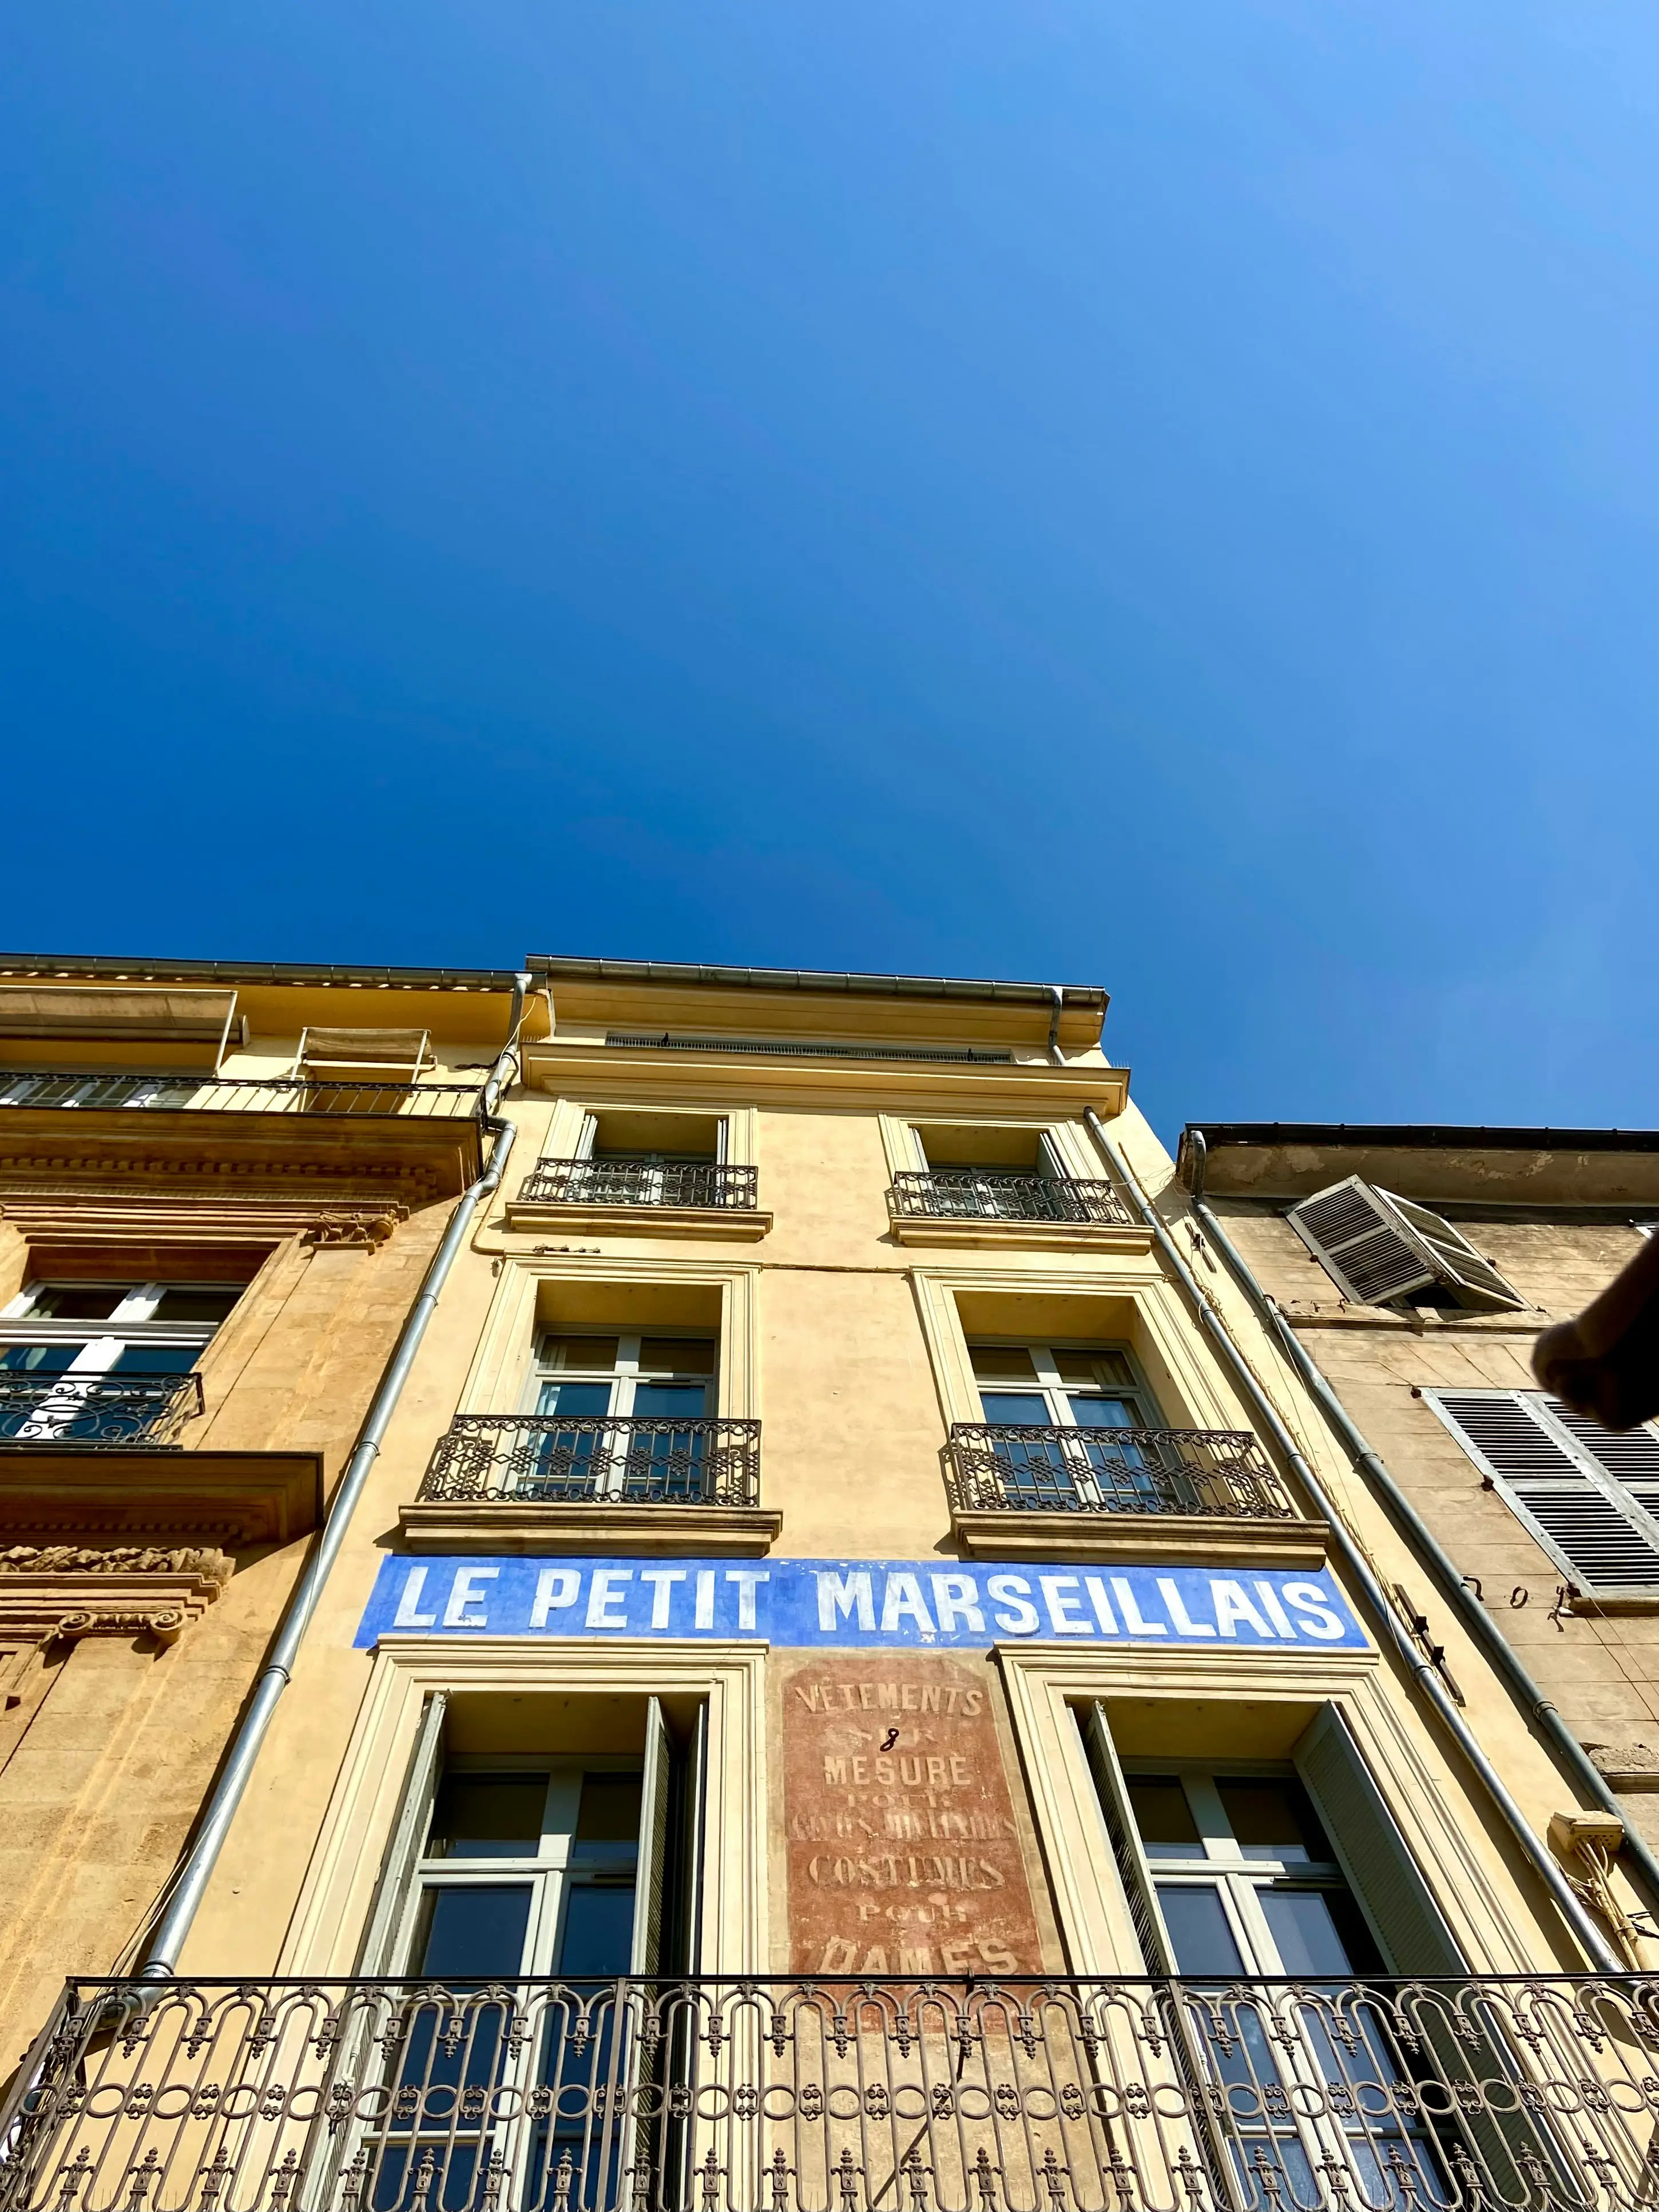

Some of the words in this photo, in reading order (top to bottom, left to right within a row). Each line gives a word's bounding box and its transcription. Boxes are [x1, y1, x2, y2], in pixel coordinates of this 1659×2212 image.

[393, 1566, 500, 1629] LE
[529, 1568, 770, 1630] PETIT
[818, 1571, 1346, 1640] MARSEILLAIS
[824, 1756, 971, 1785] MESURE
[817, 1936, 1018, 1976] DAMES
